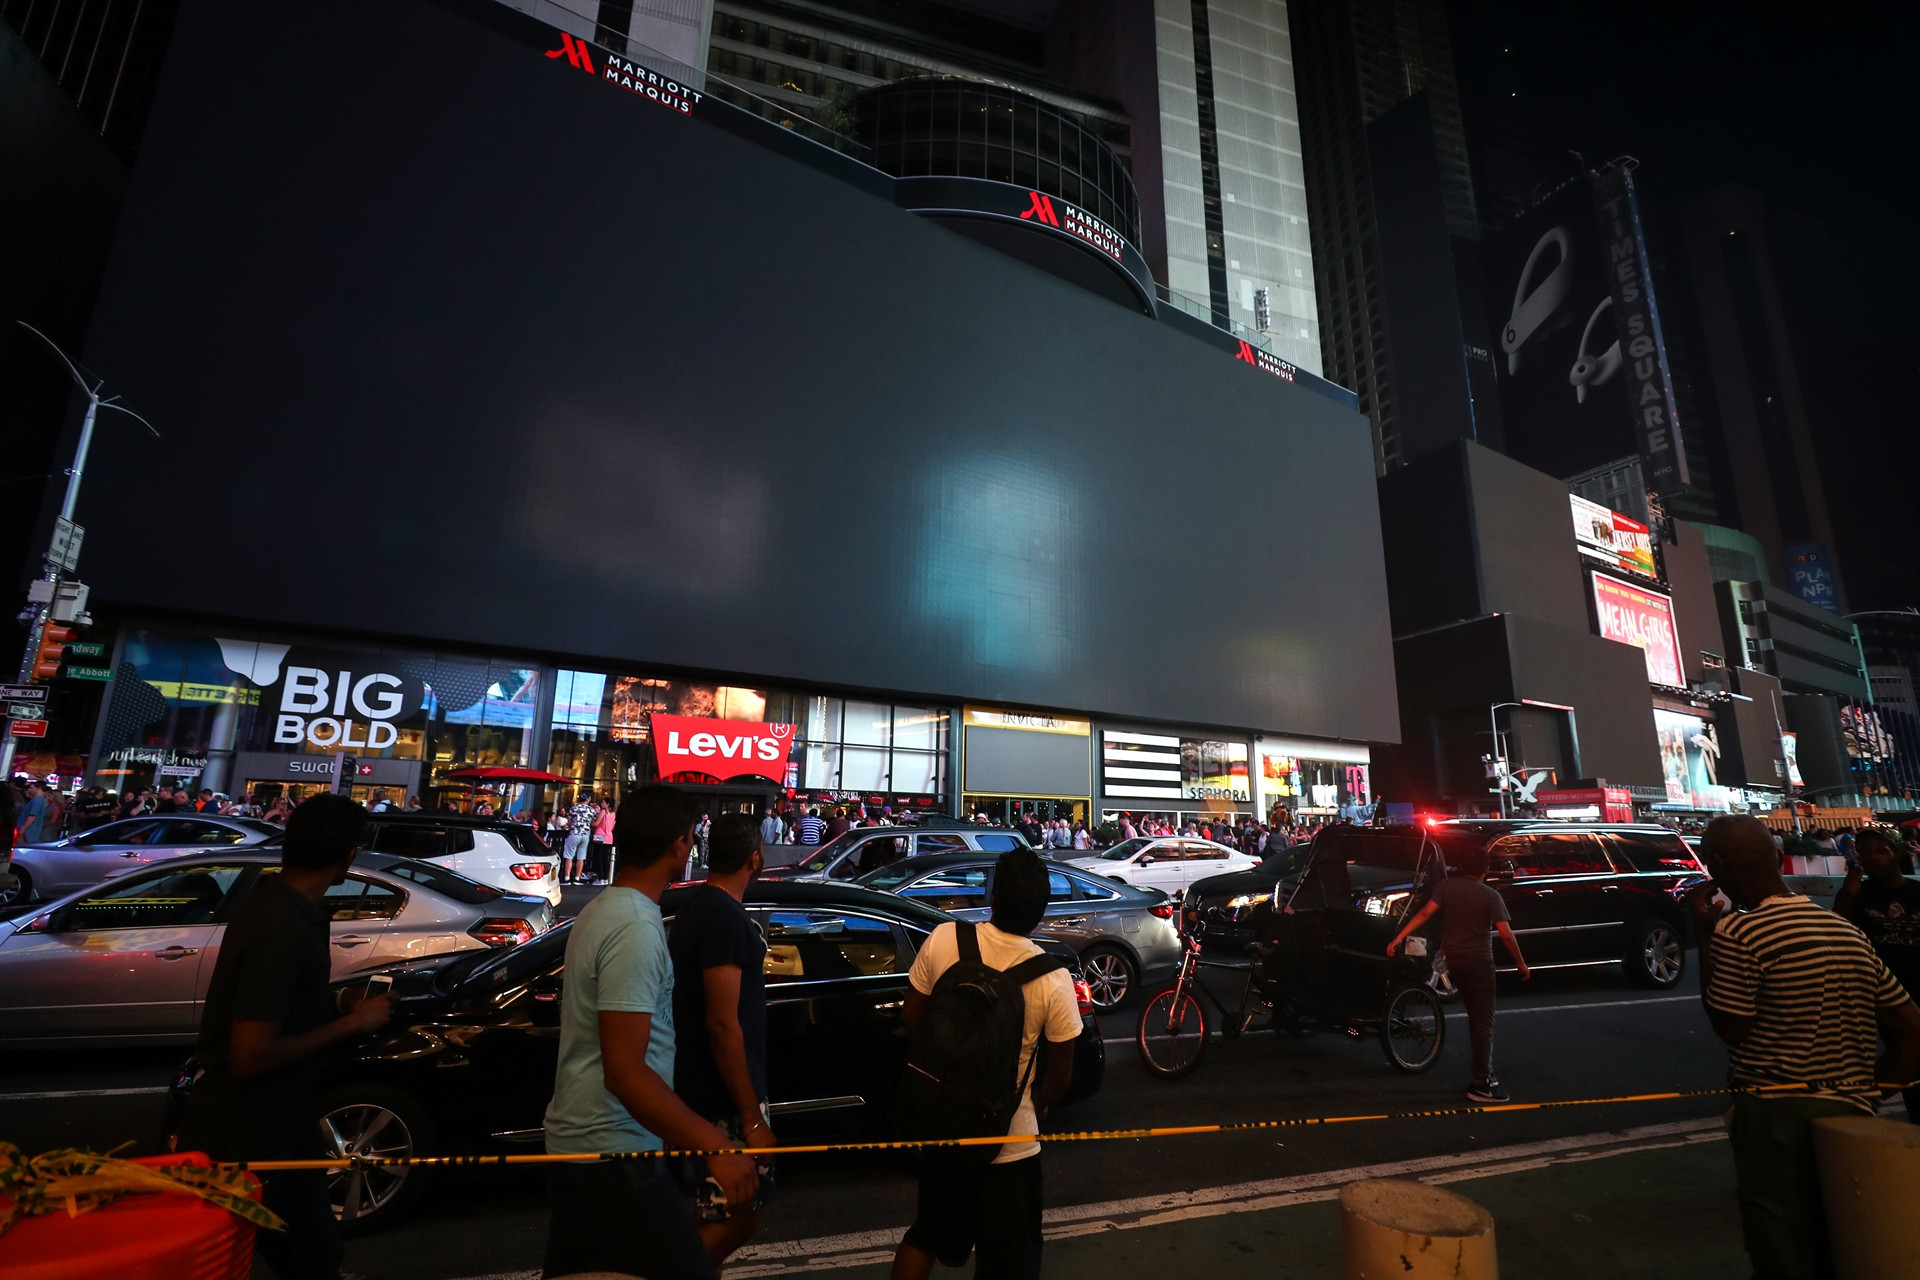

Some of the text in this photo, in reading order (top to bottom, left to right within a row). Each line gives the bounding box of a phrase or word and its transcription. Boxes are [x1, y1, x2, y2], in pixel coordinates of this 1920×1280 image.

[606, 68, 690, 113] MARQUIS
[608, 55, 702, 103] MARRIOTT
[1066, 206, 1124, 249] MARRIOTT
[1066, 219, 1120, 258] MARQUIS
[1602, 195, 1669, 453] TIMES SQUARE
[1258, 350, 1296, 374] MARRIOTT
[1258, 359, 1293, 381] MARQUIS
[1653, 465, 1672, 477] NYC
[59, 537, 75, 551] MUST
[1599, 600, 1673, 651] MEAN GIRLS
[80, 668, 110, 677] Abbott
[280, 665, 403, 719] BIG
[274, 714, 398, 749] BOLD
[1002, 711, 1057, 728] INVICTA
[1191, 787, 1247, 801] SEPHORA
